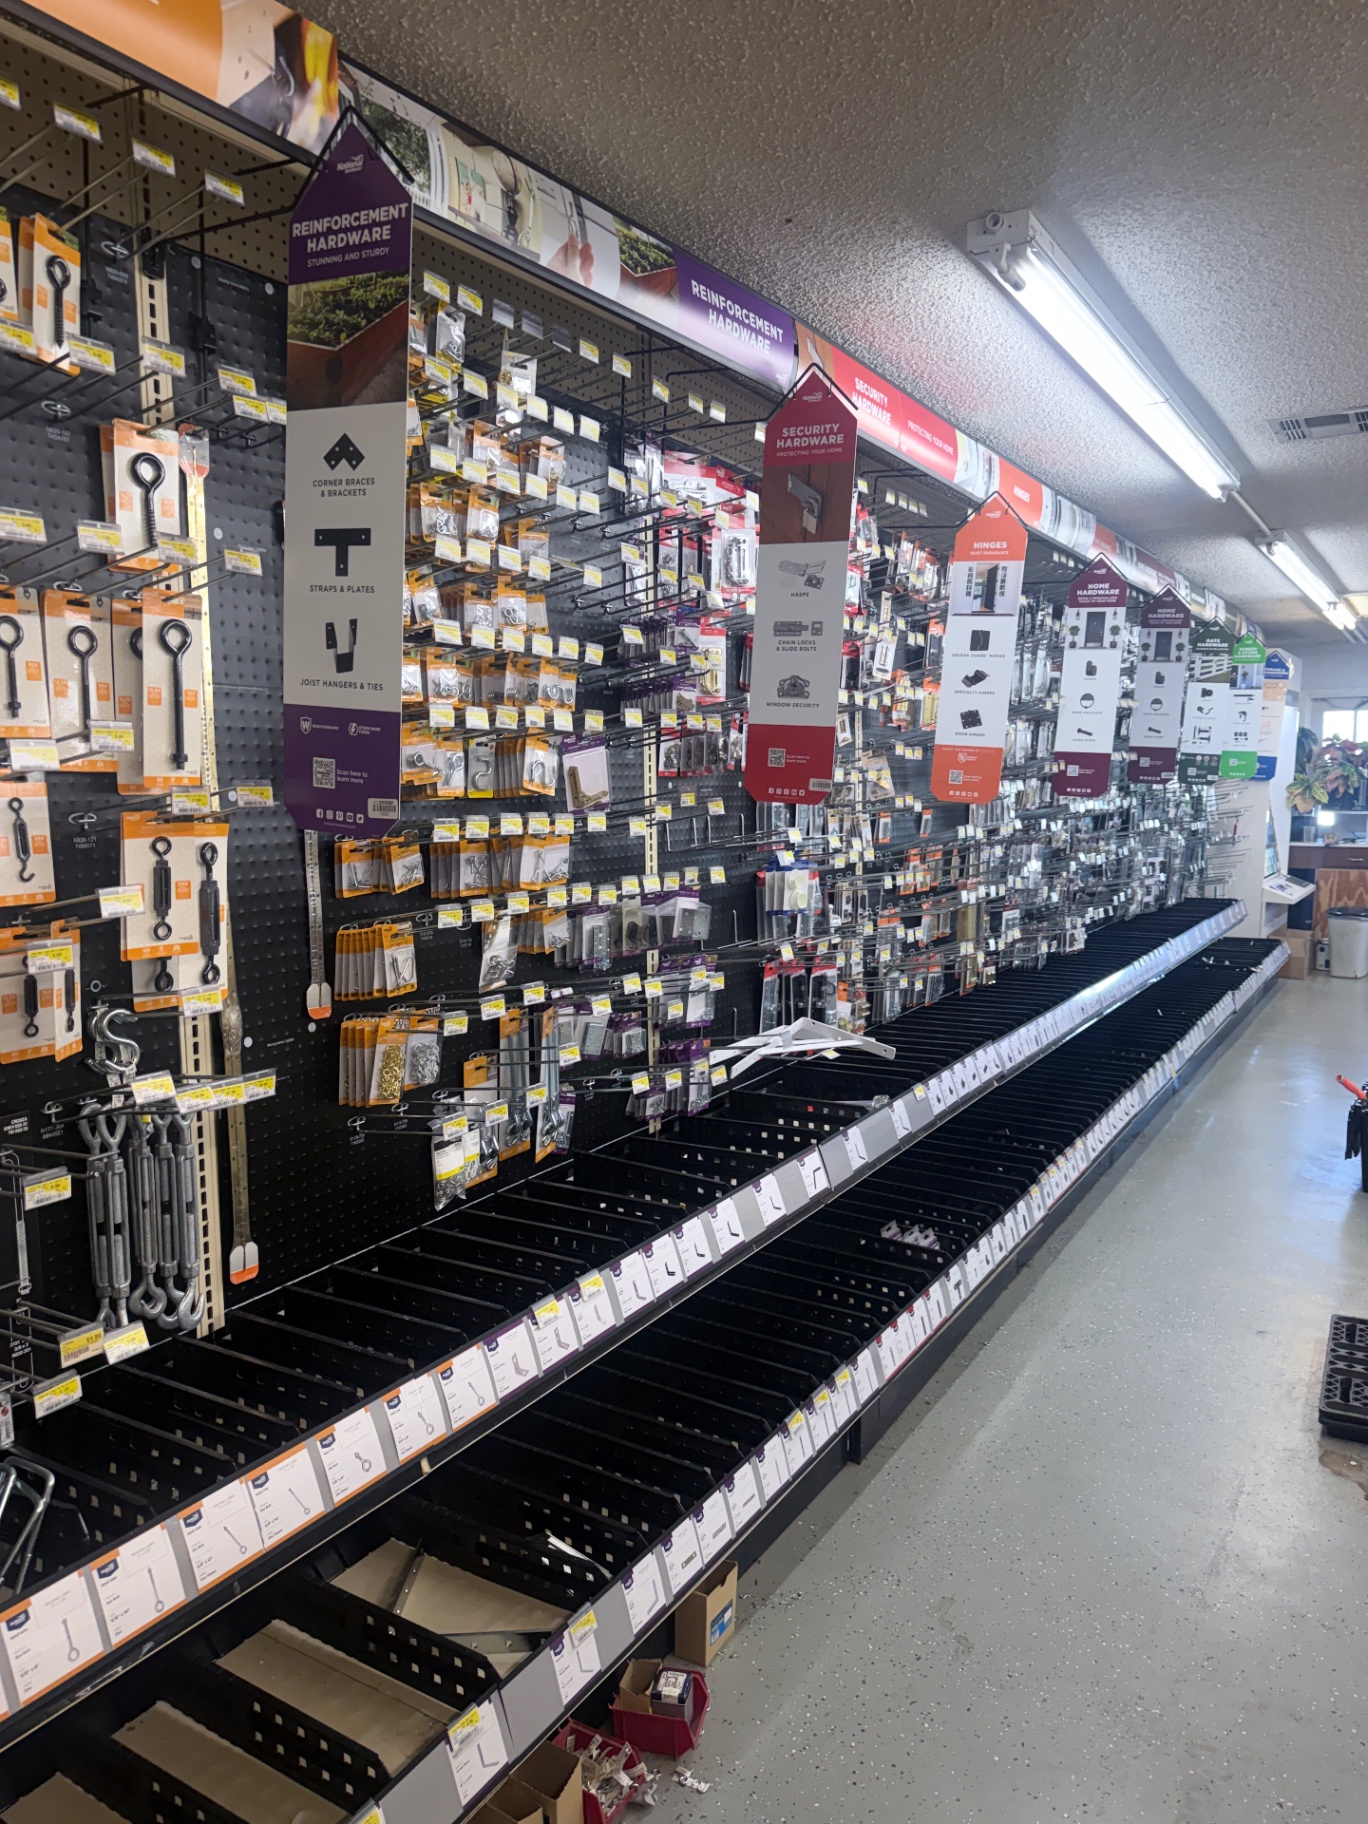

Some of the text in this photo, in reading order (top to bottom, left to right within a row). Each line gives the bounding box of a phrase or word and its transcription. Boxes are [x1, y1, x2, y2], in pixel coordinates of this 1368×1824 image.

[292, 203, 408, 238] REINFORCEMENT
[307, 225, 391, 253] HARDWARE
[307, 247, 390, 267] STUNNING AND STURDY
[691, 279, 783, 343] REINFORCEMENT
[709, 308, 771, 355] HARDWARE
[854, 377, 888, 408] SECURITY
[851, 391, 891, 426] HARDWARE
[782, 423, 840, 437] SECURITY
[907, 420, 954, 456] PROTECTING YOUR HOME
[776, 434, 844, 449] HARDWARE
[313, 478, 375, 488] CORNER BRACES
[327, 488, 367, 497] BRACKETS
[1013, 485, 1031, 503] HINGES
[973, 541, 1007, 549] HINGES
[309, 585, 337, 593] STRAPS
[347, 585, 375, 593] PLATES
[300, 679, 320, 687] JOIST
[322, 680, 357, 689] HANGERS
[367, 683, 383, 691] TIES
